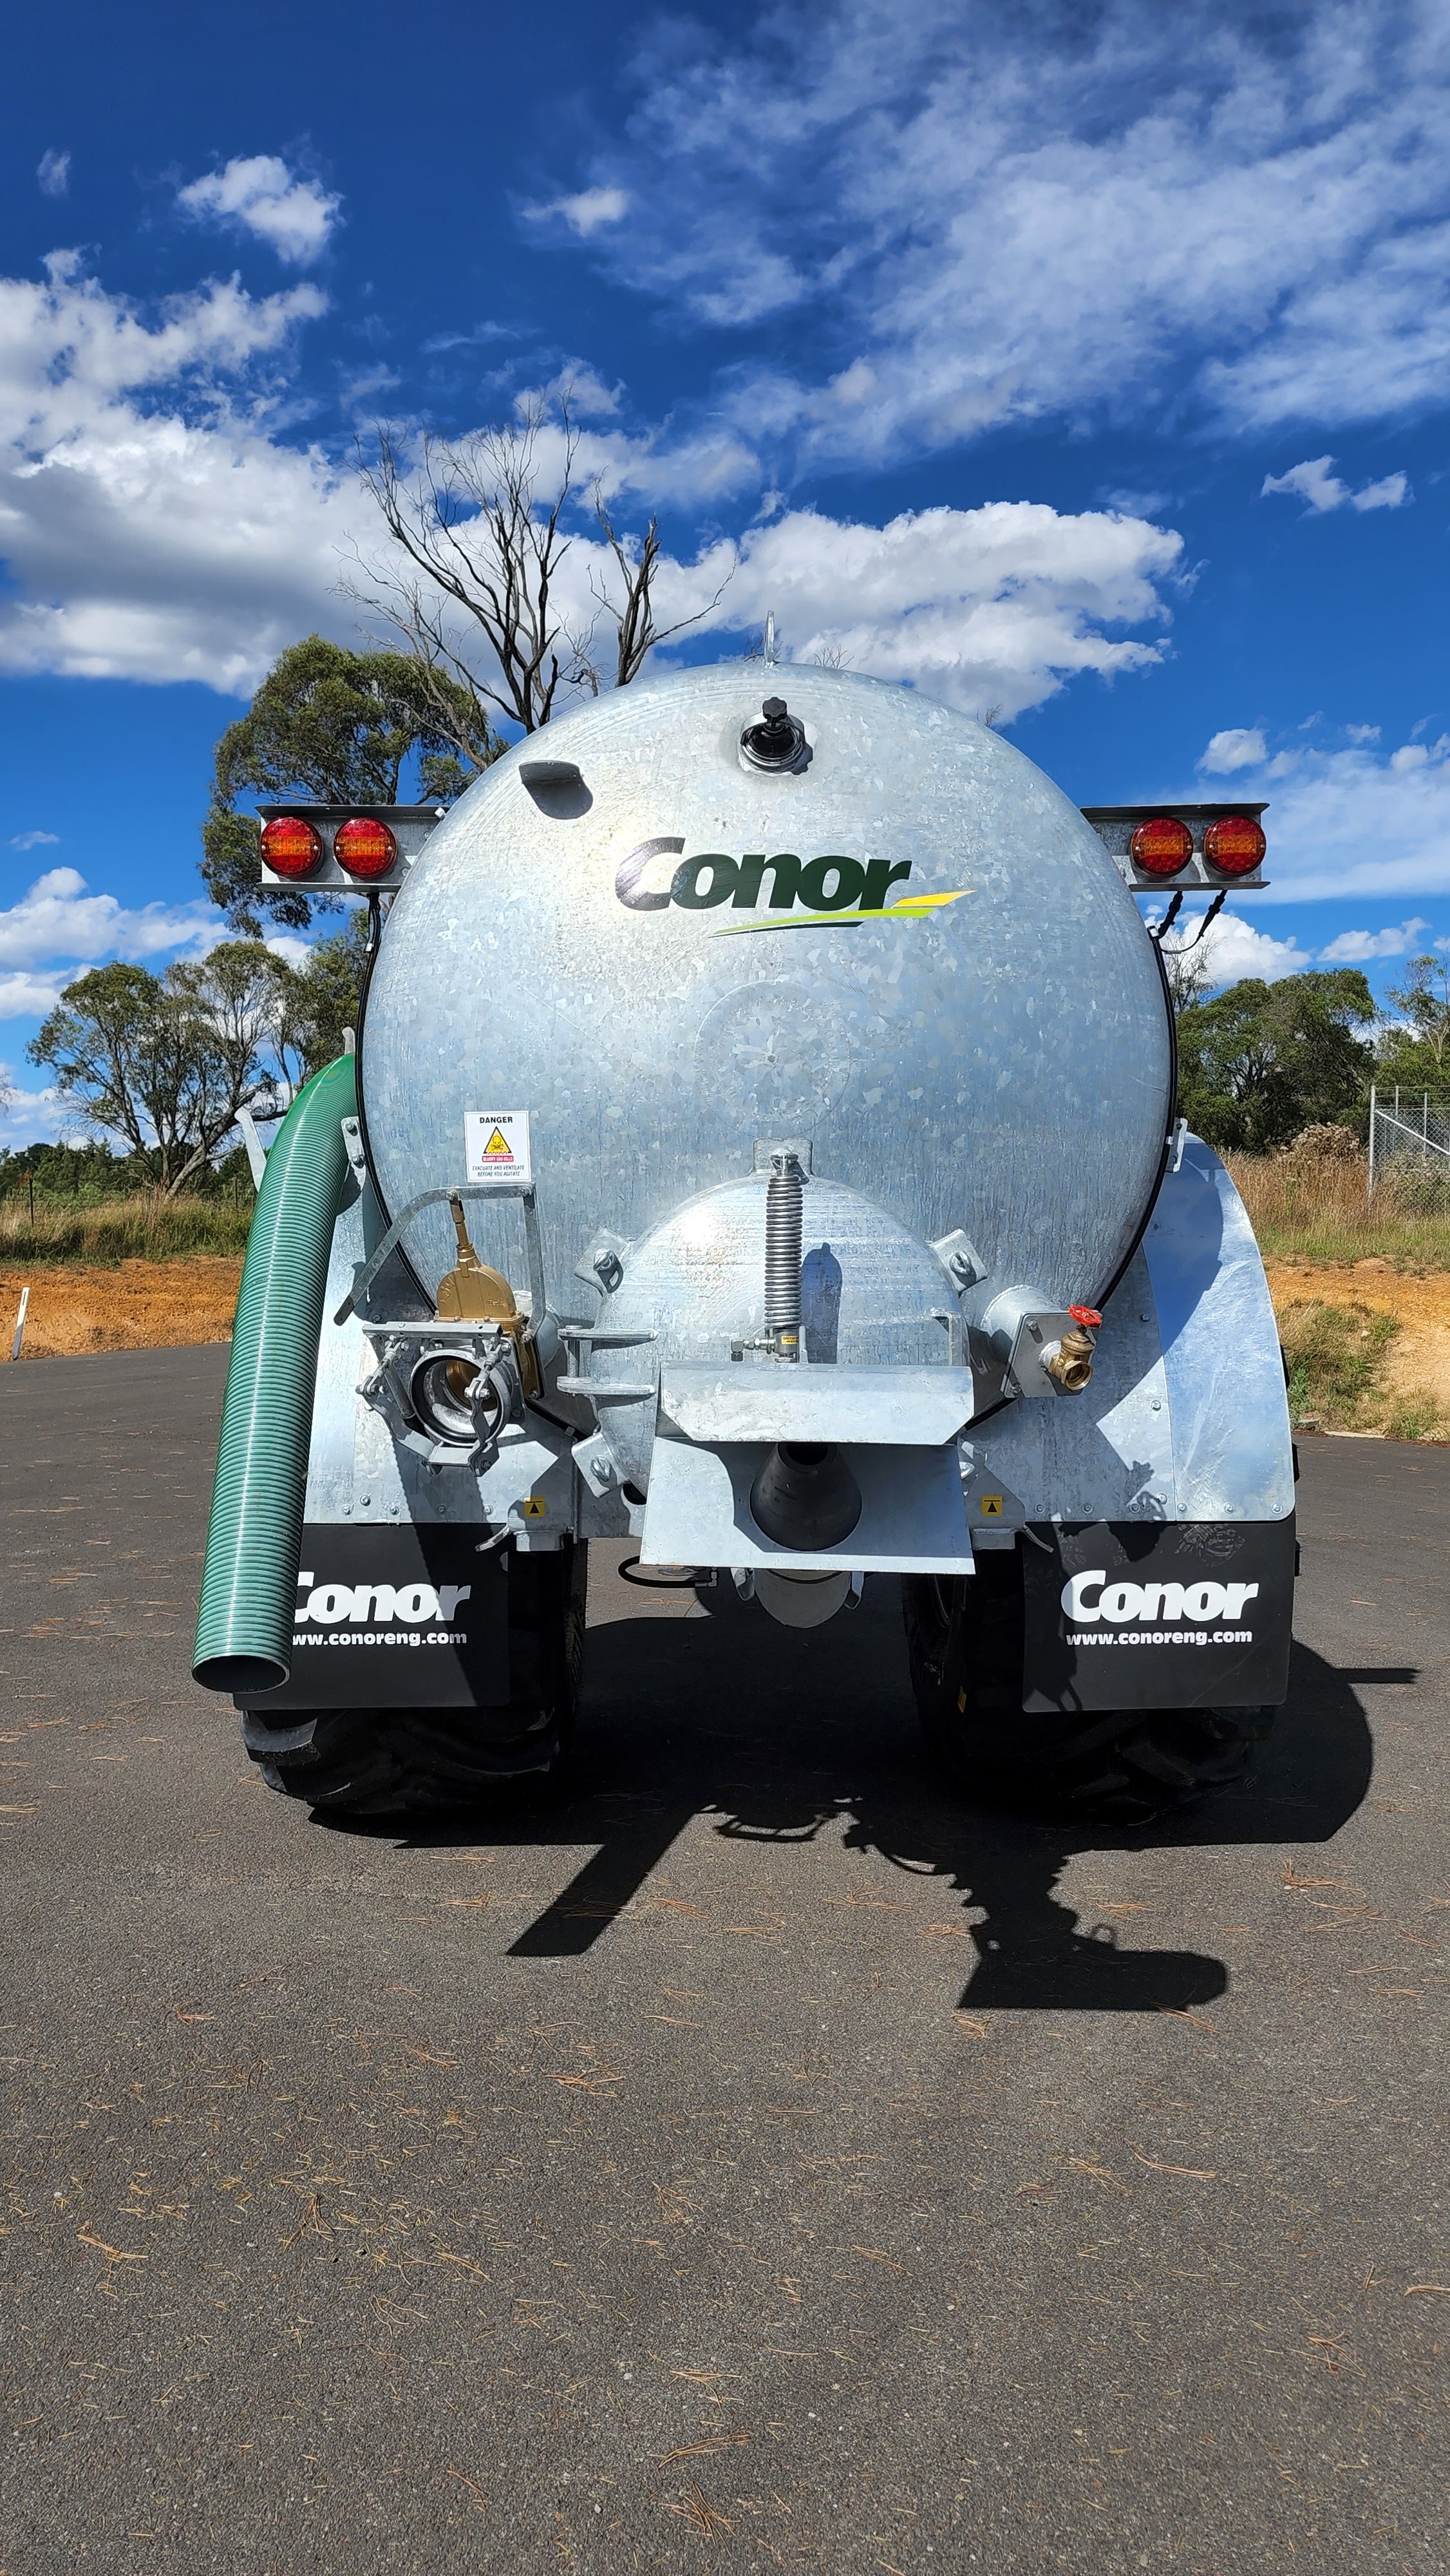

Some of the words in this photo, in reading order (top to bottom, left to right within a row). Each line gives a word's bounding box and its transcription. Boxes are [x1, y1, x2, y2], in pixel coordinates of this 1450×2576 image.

[615, 837, 912, 911] Conor
[1060, 1569, 1259, 1623] Conor
[292, 1631, 467, 1647] ww.conoreng.com
[1066, 1630, 1252, 1646] www.conoreng.com
